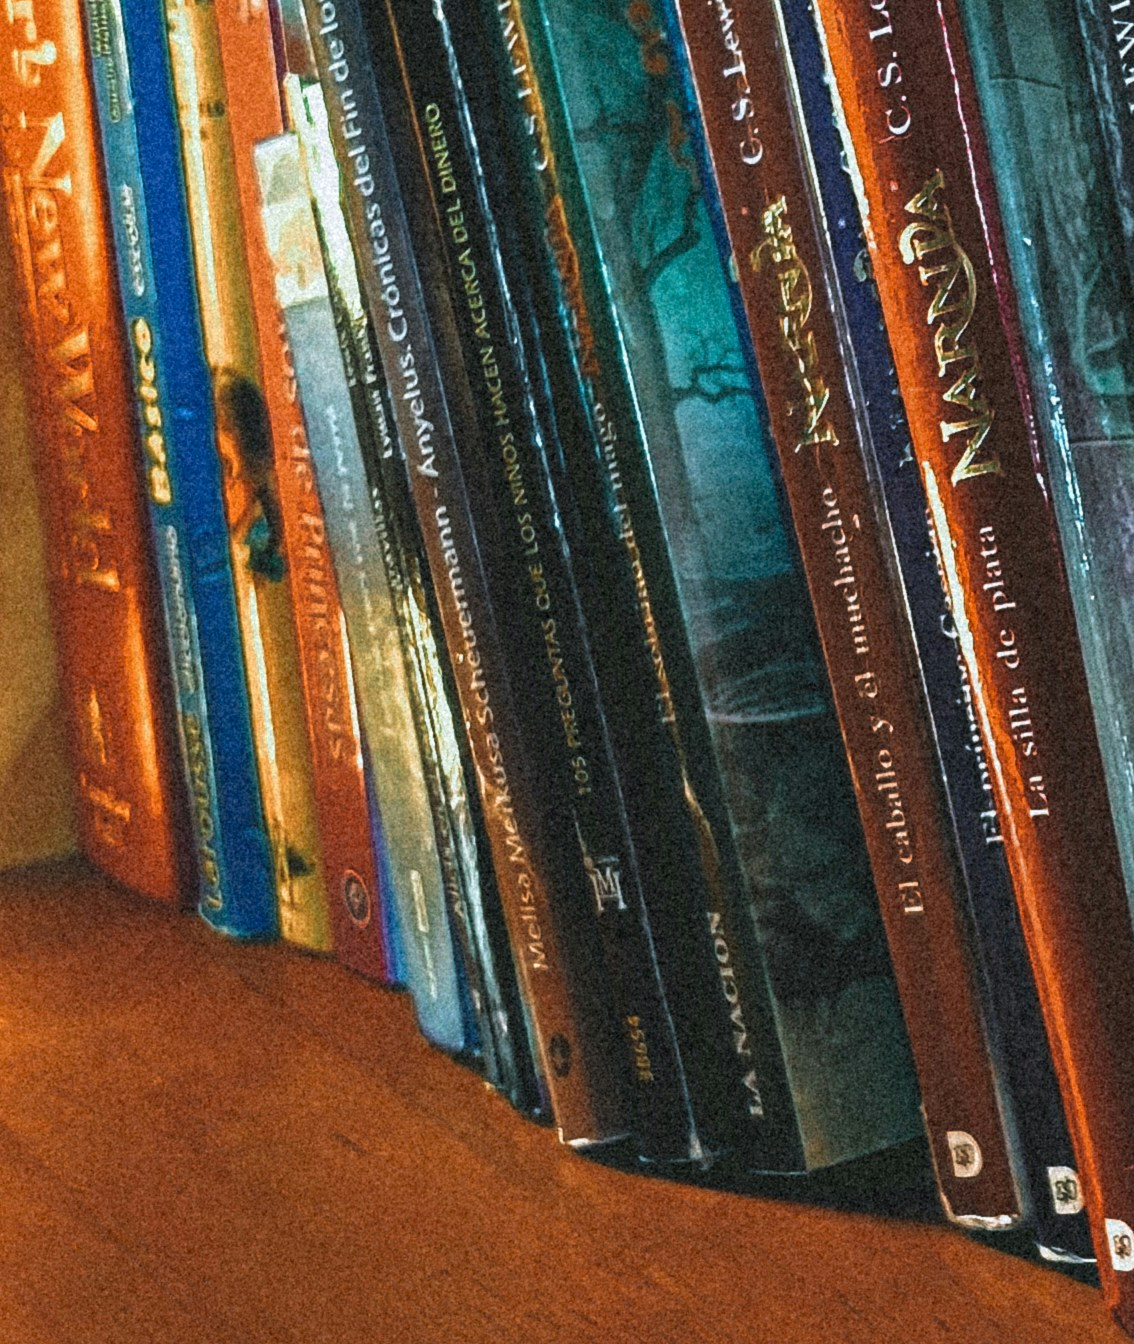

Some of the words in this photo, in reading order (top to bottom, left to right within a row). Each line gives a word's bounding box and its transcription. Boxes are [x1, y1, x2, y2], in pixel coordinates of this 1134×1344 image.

[326, 40, 349, 83] de
[874, 51, 903, 88] S.
[338, 89, 362, 140] Fin
[883, 95, 912, 139] C.
[347, 145, 374, 196] del
[425, 102, 457, 194] DINERO
[447, 198, 469, 244] DEL
[366, 203, 408, 343] Crónicas
[457, 248, 490, 339] ACERCA
[896, 168, 1001, 489] NARNIA
[479, 345, 510, 426] HACEN
[591, 402, 623, 492] mago
[517, 512, 540, 555] LOS
[611, 503, 636, 550] del
[527, 564, 551, 611] QUE
[820, 485, 870, 655] muchacho
[978, 525, 1017, 612] plata
[994, 629, 1020, 669] de
[541, 618, 582, 748] PREGUNTAS
[871, 718, 895, 734] y
[1006, 686, 1035, 757] silla
[570, 755, 592, 795] 105
[1018, 775, 1050, 822] La
[874, 748, 913, 865] caballo
[516, 872, 548, 970] Melisa
[898, 880, 924, 914] El
[706, 911, 751, 1055] NACION
[742, 1070, 764, 1117] LA
